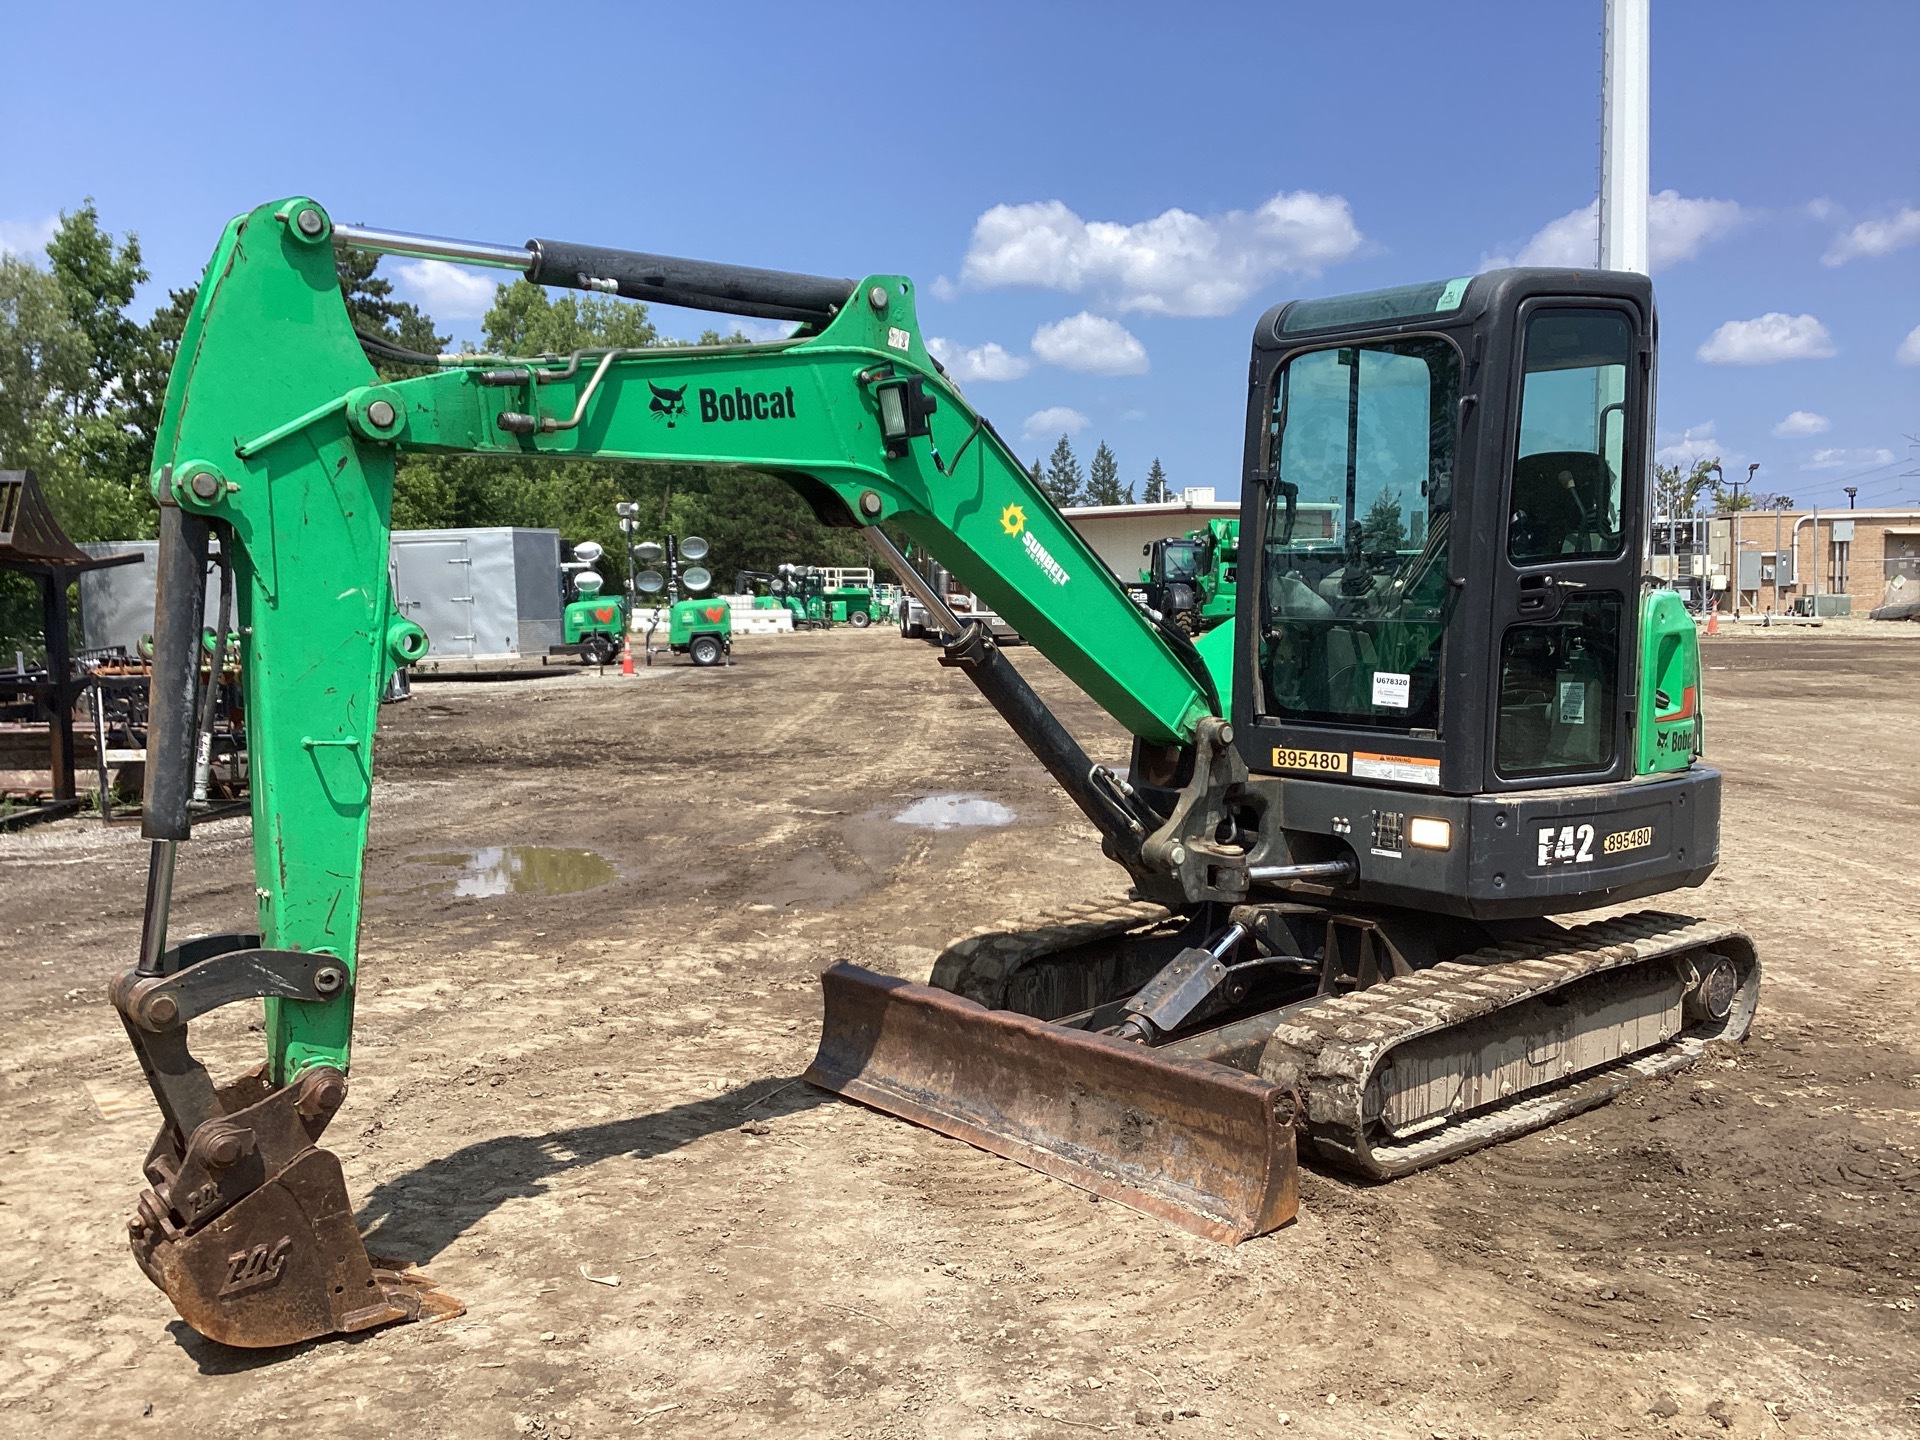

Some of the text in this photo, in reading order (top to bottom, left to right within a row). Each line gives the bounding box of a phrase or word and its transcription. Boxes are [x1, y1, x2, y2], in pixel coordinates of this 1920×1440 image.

[699, 386, 796, 422] Bobcat
[1022, 530, 1071, 586] SUNBELT
[1025, 547, 1058, 585] RENTALS
[1376, 677, 1408, 686] U678320
[1277, 750, 1341, 770] 895480
[1537, 824, 1595, 866] E42
[1608, 828, 1650, 851] 895480
